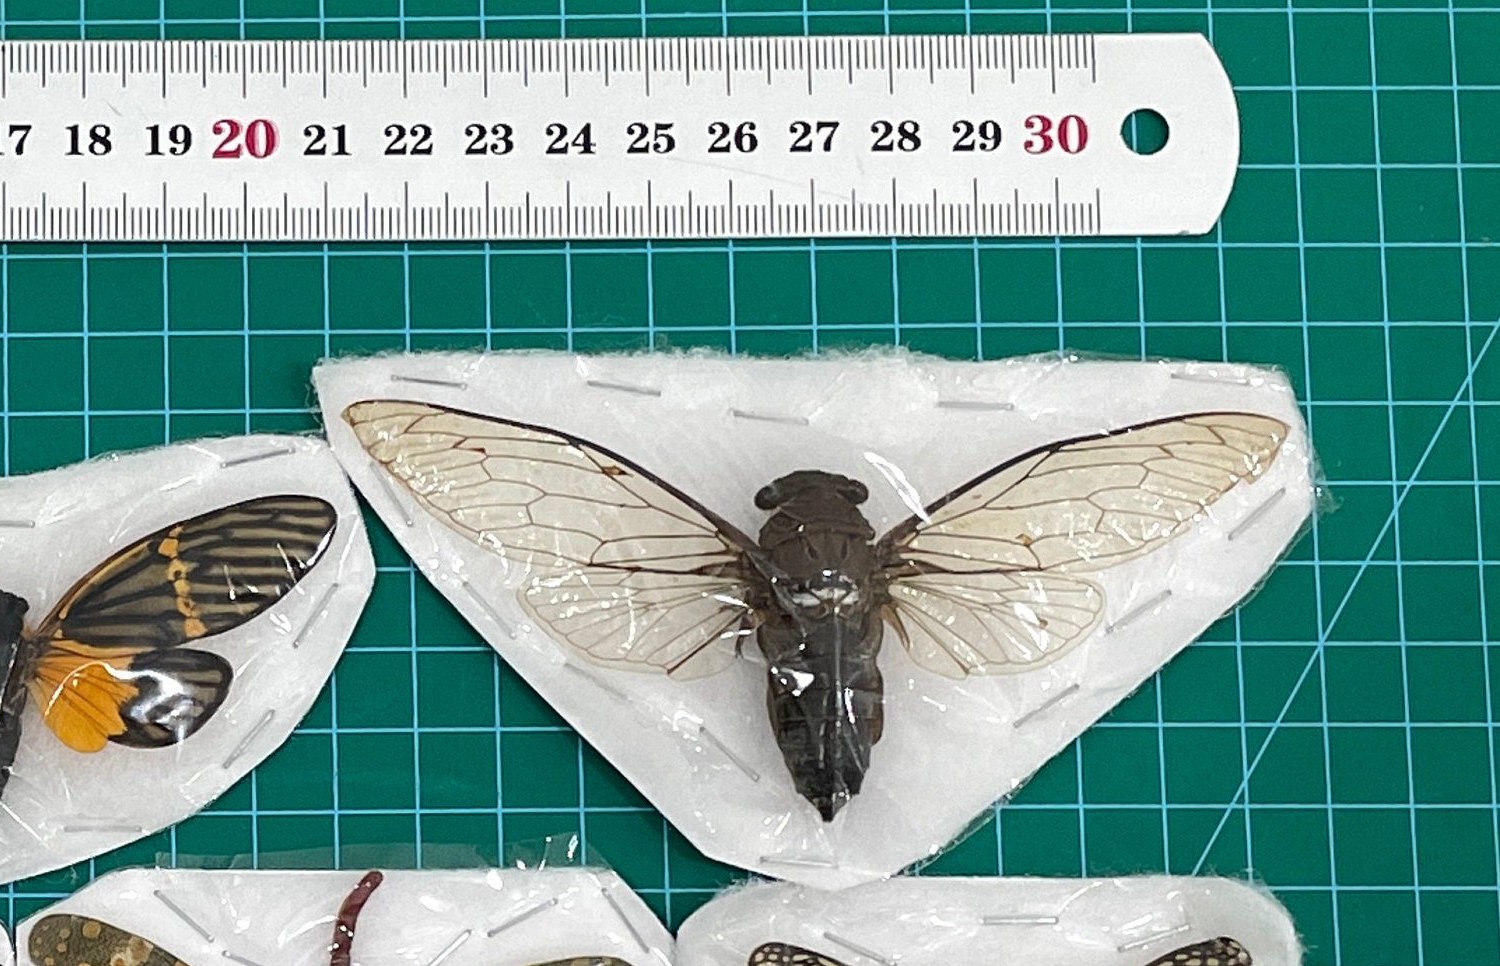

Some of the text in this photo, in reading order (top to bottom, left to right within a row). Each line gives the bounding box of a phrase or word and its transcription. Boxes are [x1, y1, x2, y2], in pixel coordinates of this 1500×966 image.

[66, 124, 112, 156] 18
[146, 124, 192, 156] 19
[212, 119, 276, 159] 20
[303, 124, 351, 156] 21
[384, 123, 434, 156] 22
[464, 123, 514, 156] 23
[545, 122, 596, 155] 24
[626, 122, 676, 154] 25
[707, 121, 758, 153] 26
[789, 120, 840, 153] 27
[870, 120, 922, 152] 28
[952, 119, 1002, 152] 29
[1024, 114, 1089, 154] 30
